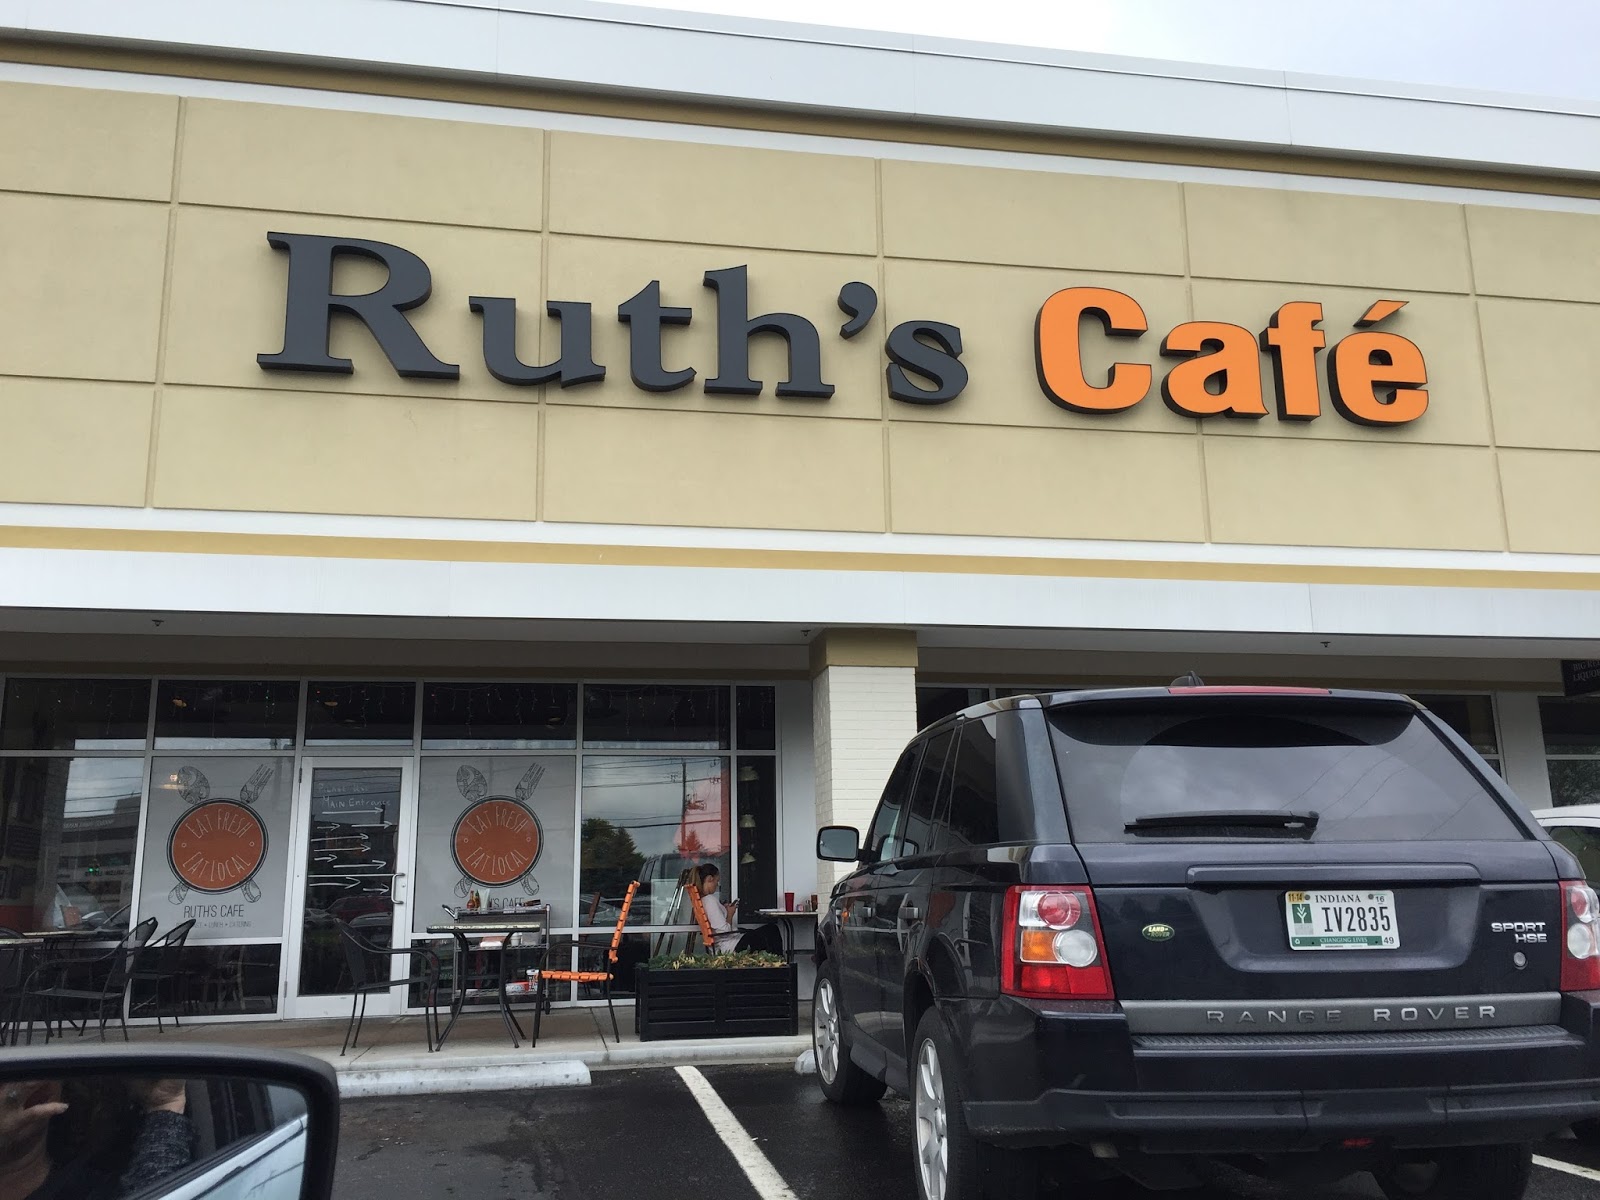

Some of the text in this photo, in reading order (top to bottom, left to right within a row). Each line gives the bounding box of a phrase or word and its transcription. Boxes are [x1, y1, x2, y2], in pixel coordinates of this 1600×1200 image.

[256, 231, 1429, 426] Ruth's Café
[185, 808, 254, 839] EAT FRESH
[466, 805, 529, 835] EAT FRESH
[182, 851, 252, 882] EAT LOCAL
[465, 846, 529, 876] EAT LOCAL
[1315, 894, 1362, 904] INDIANA
[183, 904, 245, 919] RUTH'S CAFE
[1321, 906, 1391, 932] IV2835
[1491, 922, 1546, 932] SPORT
[1515, 933, 1547, 943] HSE
[1383, 937, 1394, 945] 49
[1206, 1005, 1496, 1025] RANGE ROVER
